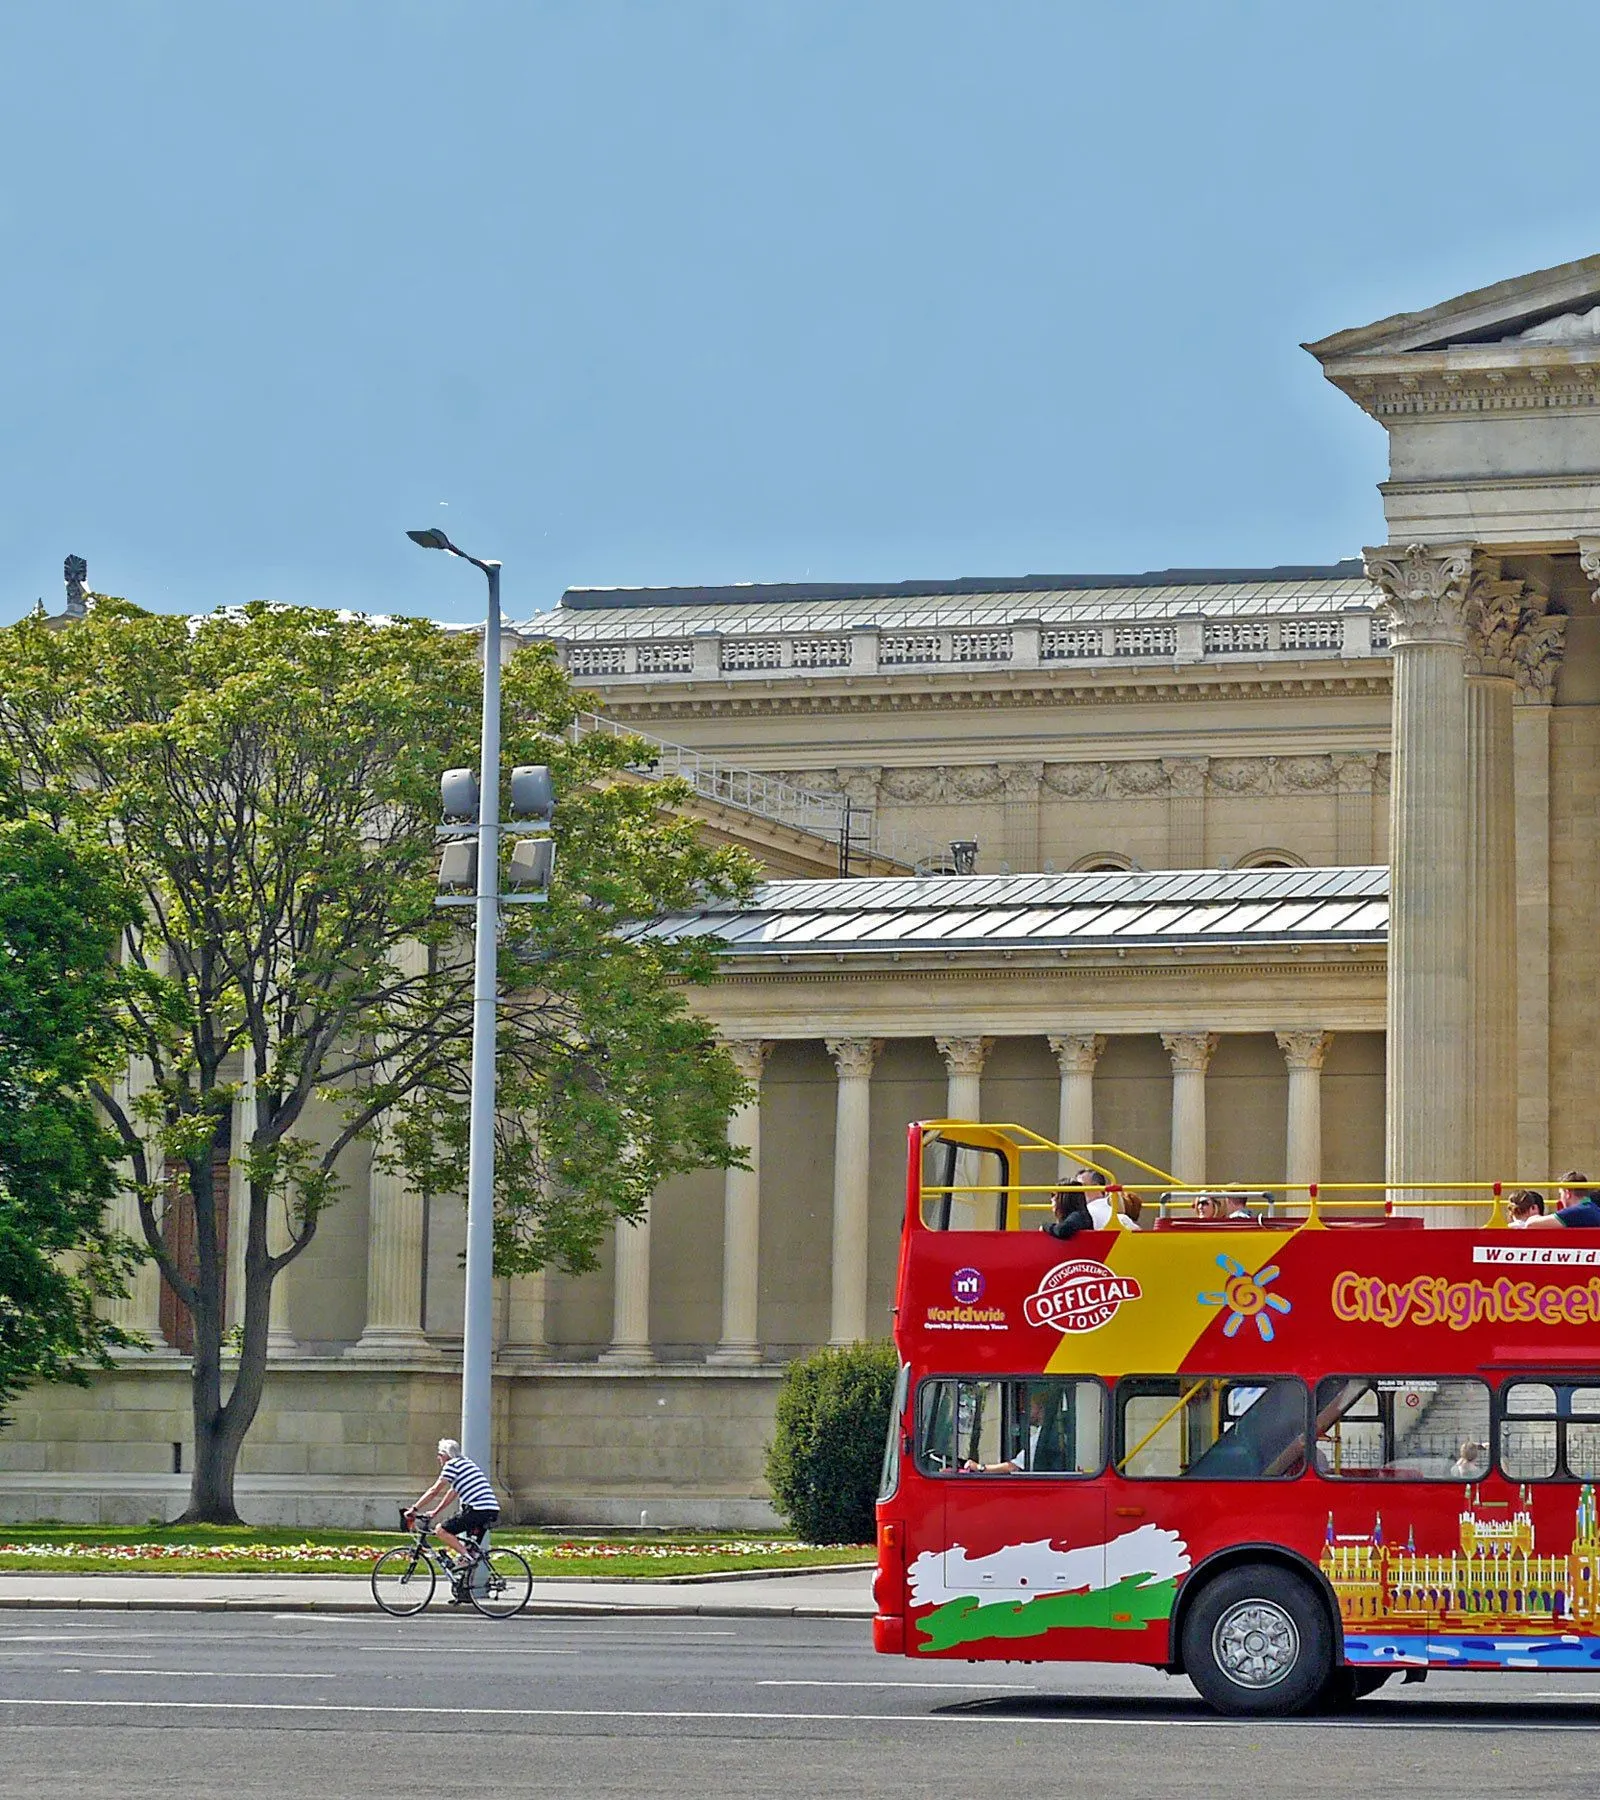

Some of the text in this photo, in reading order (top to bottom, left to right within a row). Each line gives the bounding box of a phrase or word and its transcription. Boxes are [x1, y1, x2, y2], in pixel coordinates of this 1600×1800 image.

[1048, 1264, 1108, 1288] CITYSIGHTSEEING
[1036, 1280, 1135, 1319] OFFICIAL
[927, 1306, 1006, 1323] Worldwide
[1069, 1307, 1111, 1328] TOUR
